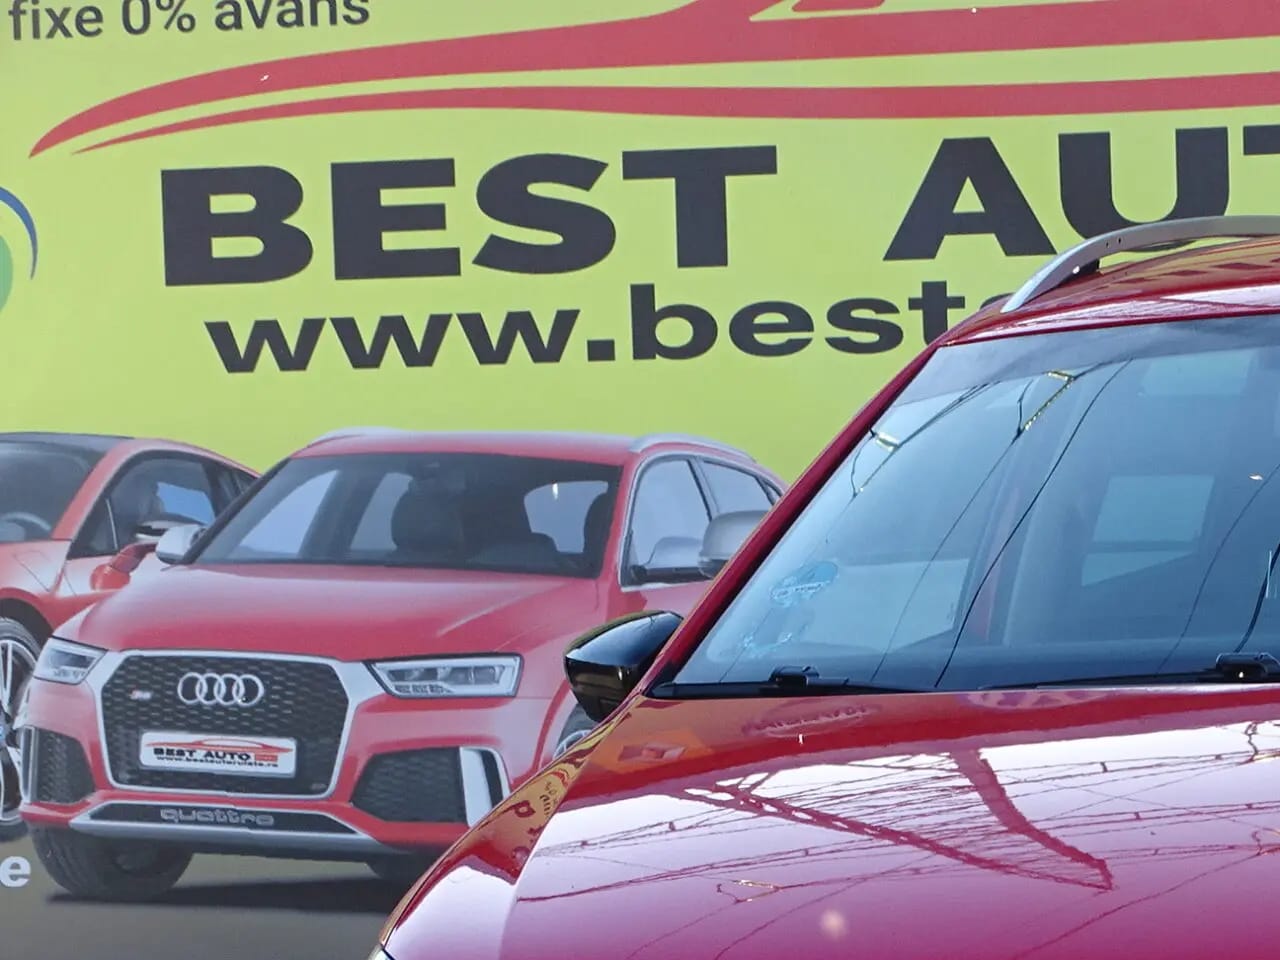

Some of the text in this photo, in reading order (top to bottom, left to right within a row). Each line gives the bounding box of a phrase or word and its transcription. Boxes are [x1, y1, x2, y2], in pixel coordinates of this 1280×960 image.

[8, 0, 370, 40] fixe 0% avans
[161, 145, 777, 286] BEST
[204, 281, 966, 374] www.best
[154, 748, 196, 757] BEST
[204, 752, 251, 761] AUTO
[160, 808, 275, 826] quattro
